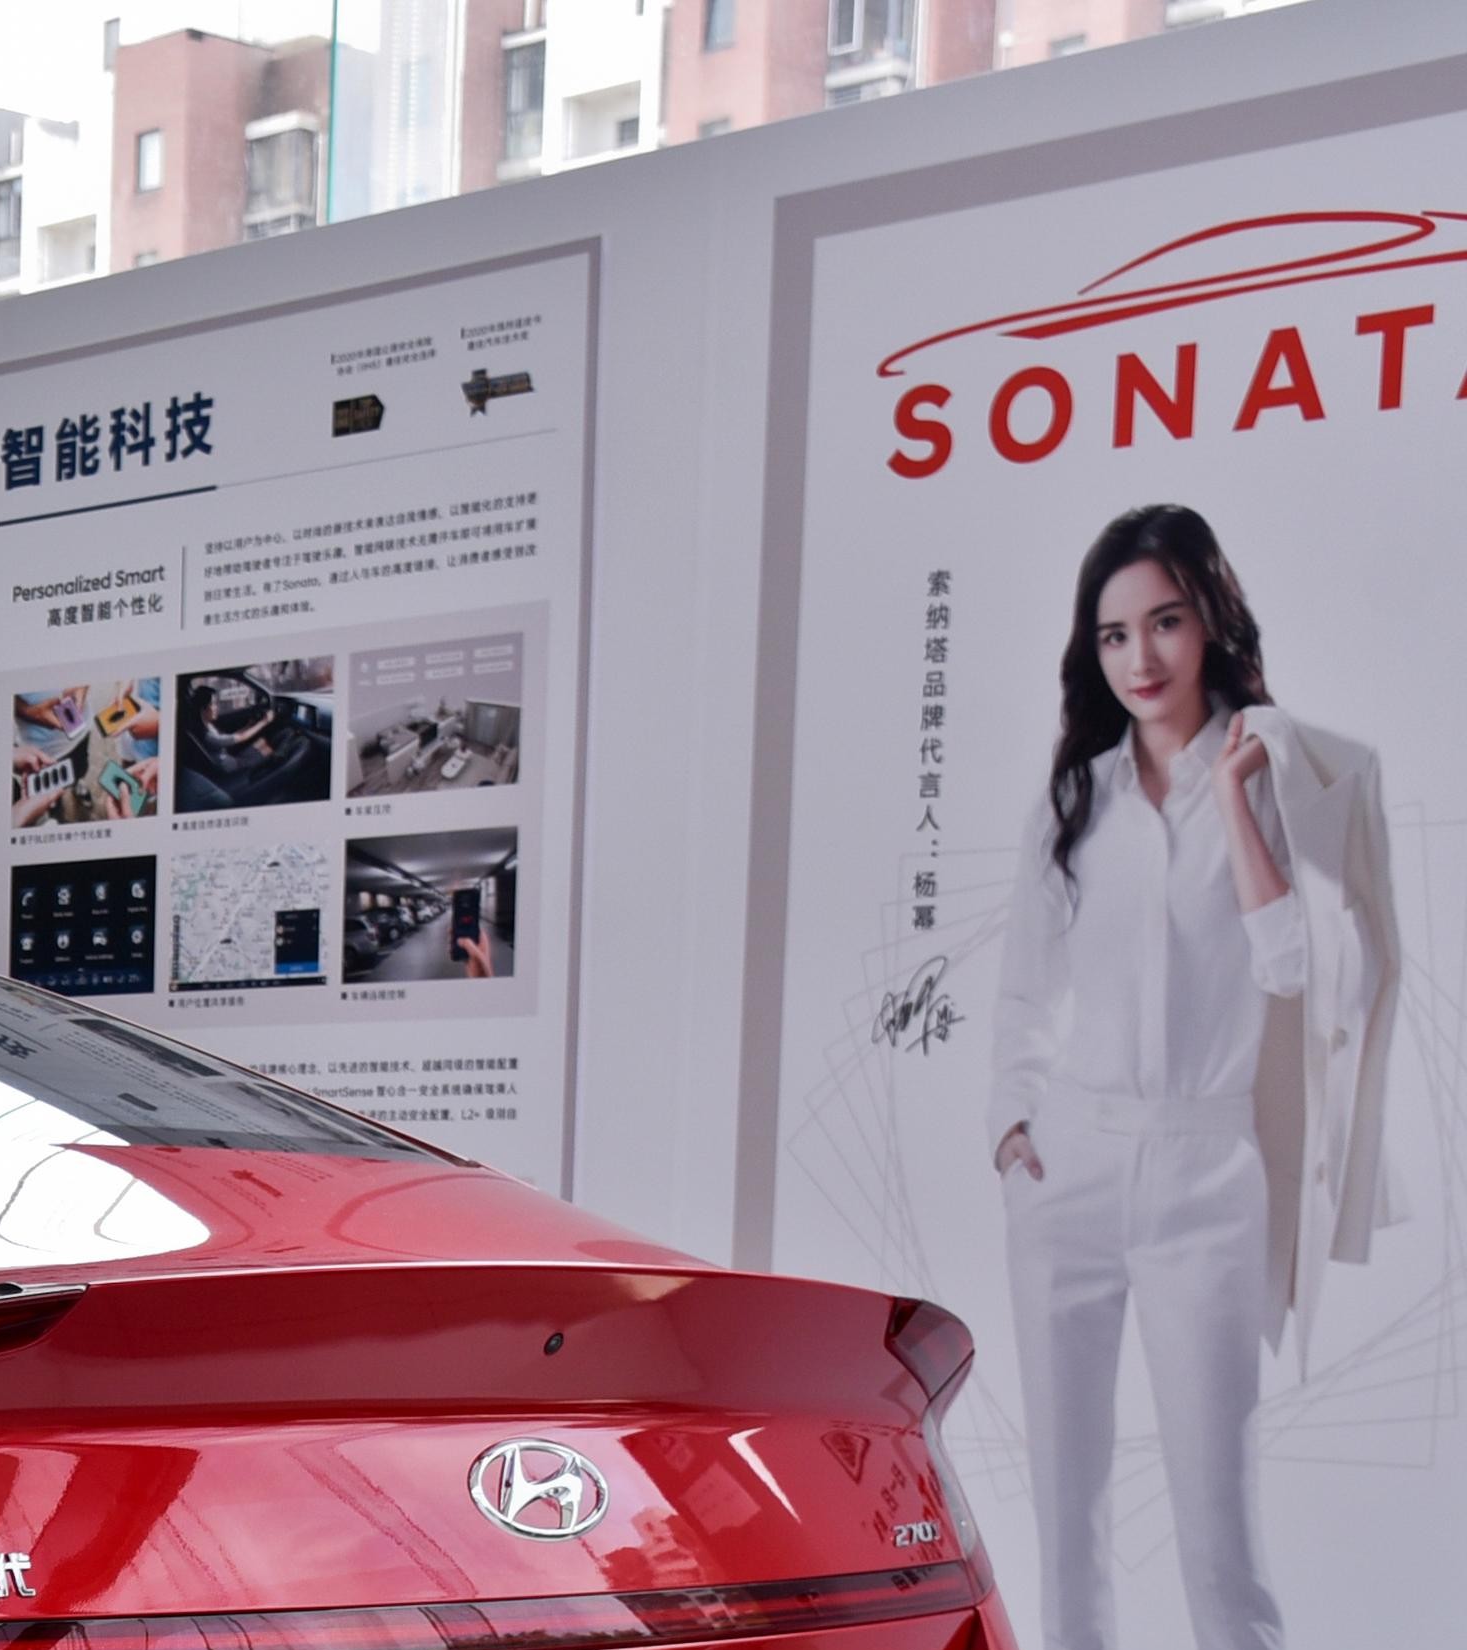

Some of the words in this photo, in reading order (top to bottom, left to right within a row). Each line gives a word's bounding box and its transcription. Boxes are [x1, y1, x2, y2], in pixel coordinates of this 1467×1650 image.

[886, 303, 1467, 479] SONAT
[0, 391, 214, 491] 智能科技
[12, 572, 111, 603] Personalized
[115, 565, 165, 589] Smart
[47, 593, 164, 628] 高度智能个性化
